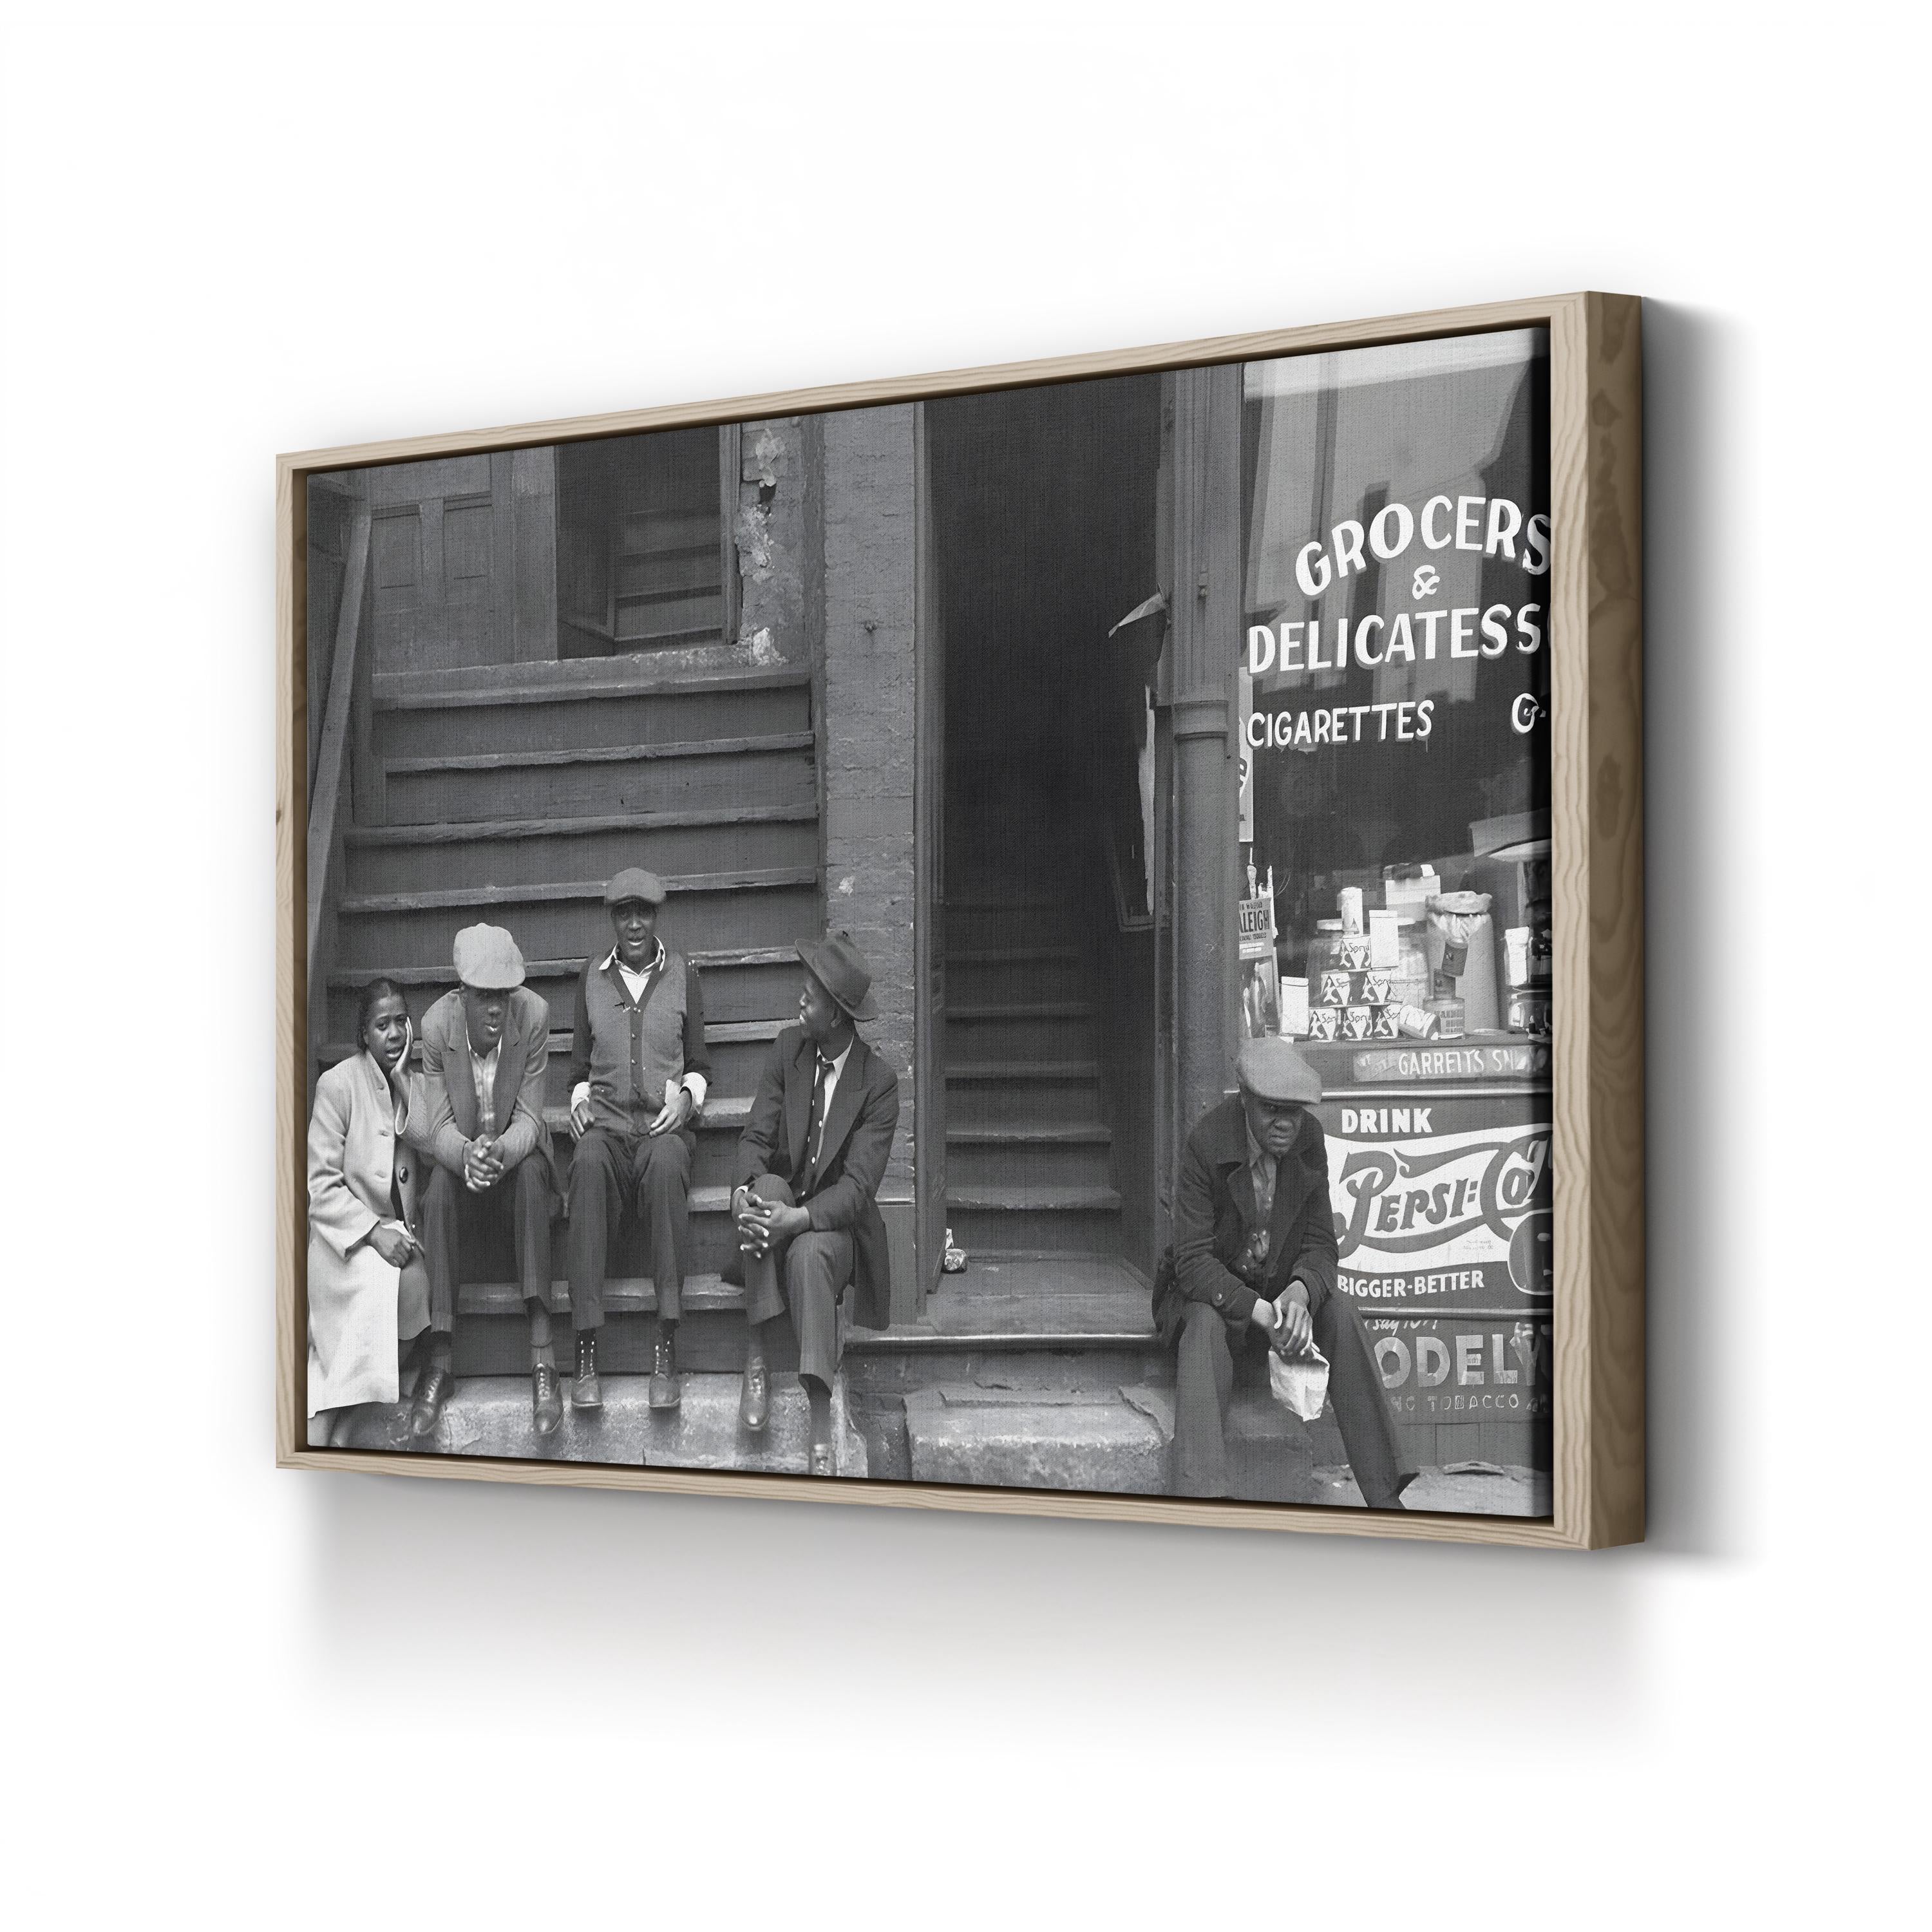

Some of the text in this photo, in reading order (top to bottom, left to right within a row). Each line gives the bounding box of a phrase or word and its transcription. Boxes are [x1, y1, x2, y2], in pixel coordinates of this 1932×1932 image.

[1412, 565, 1440, 600] &
[1247, 603, 1551, 674] DELICATESS
[1247, 699, 1435, 748] CIGARETTES
[1341, 1108, 1432, 1133] DRINK
[1337, 1270, 1484, 1298] BIGGER-BETTER
